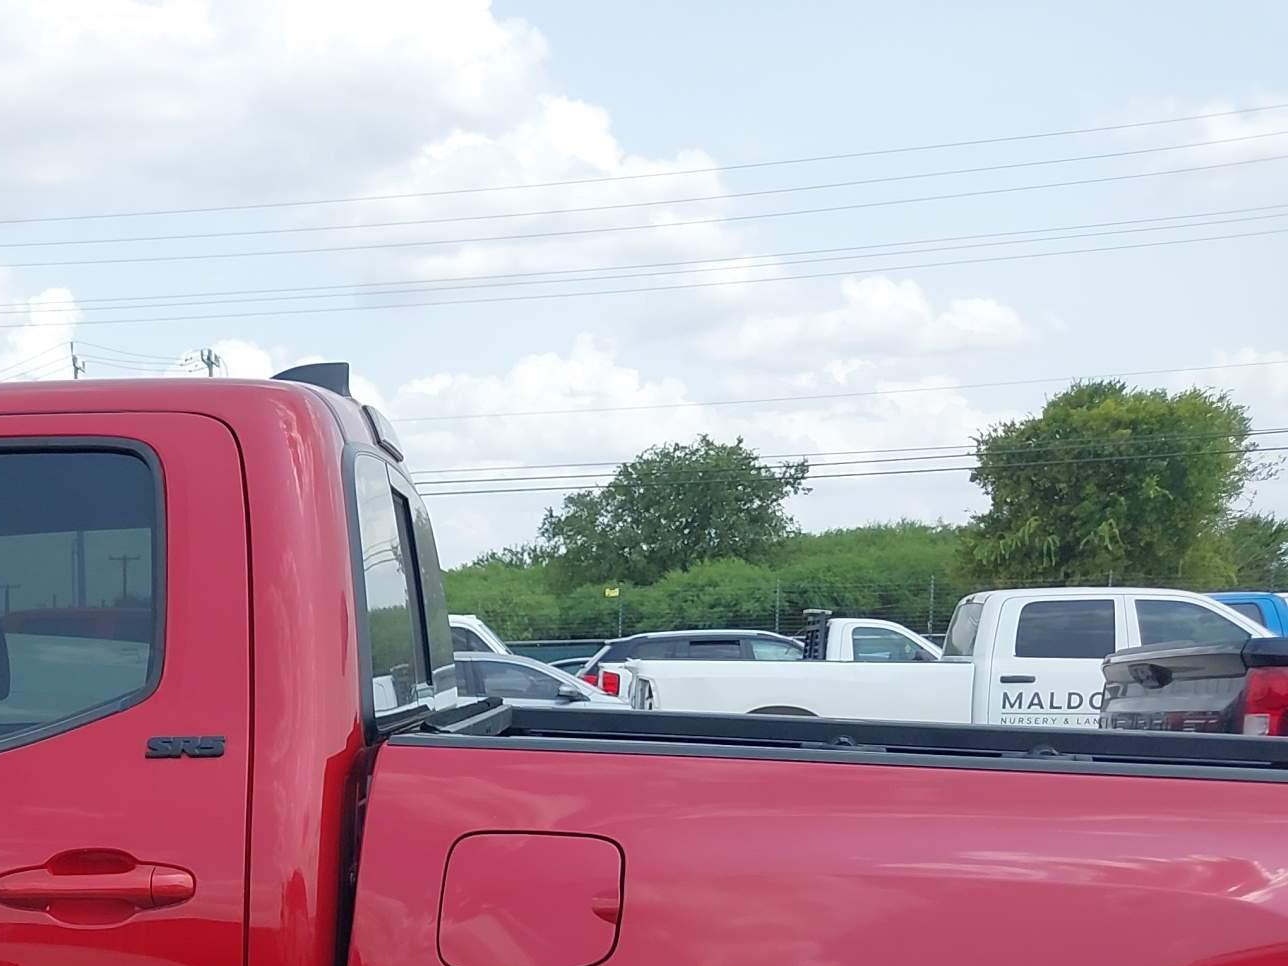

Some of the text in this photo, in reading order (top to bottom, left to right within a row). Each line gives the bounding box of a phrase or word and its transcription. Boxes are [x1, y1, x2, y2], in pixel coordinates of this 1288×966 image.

[1000, 717, 1057, 725] NURSERY
[1063, 717, 1070, 725] &
[145, 736, 226, 759] SR5
